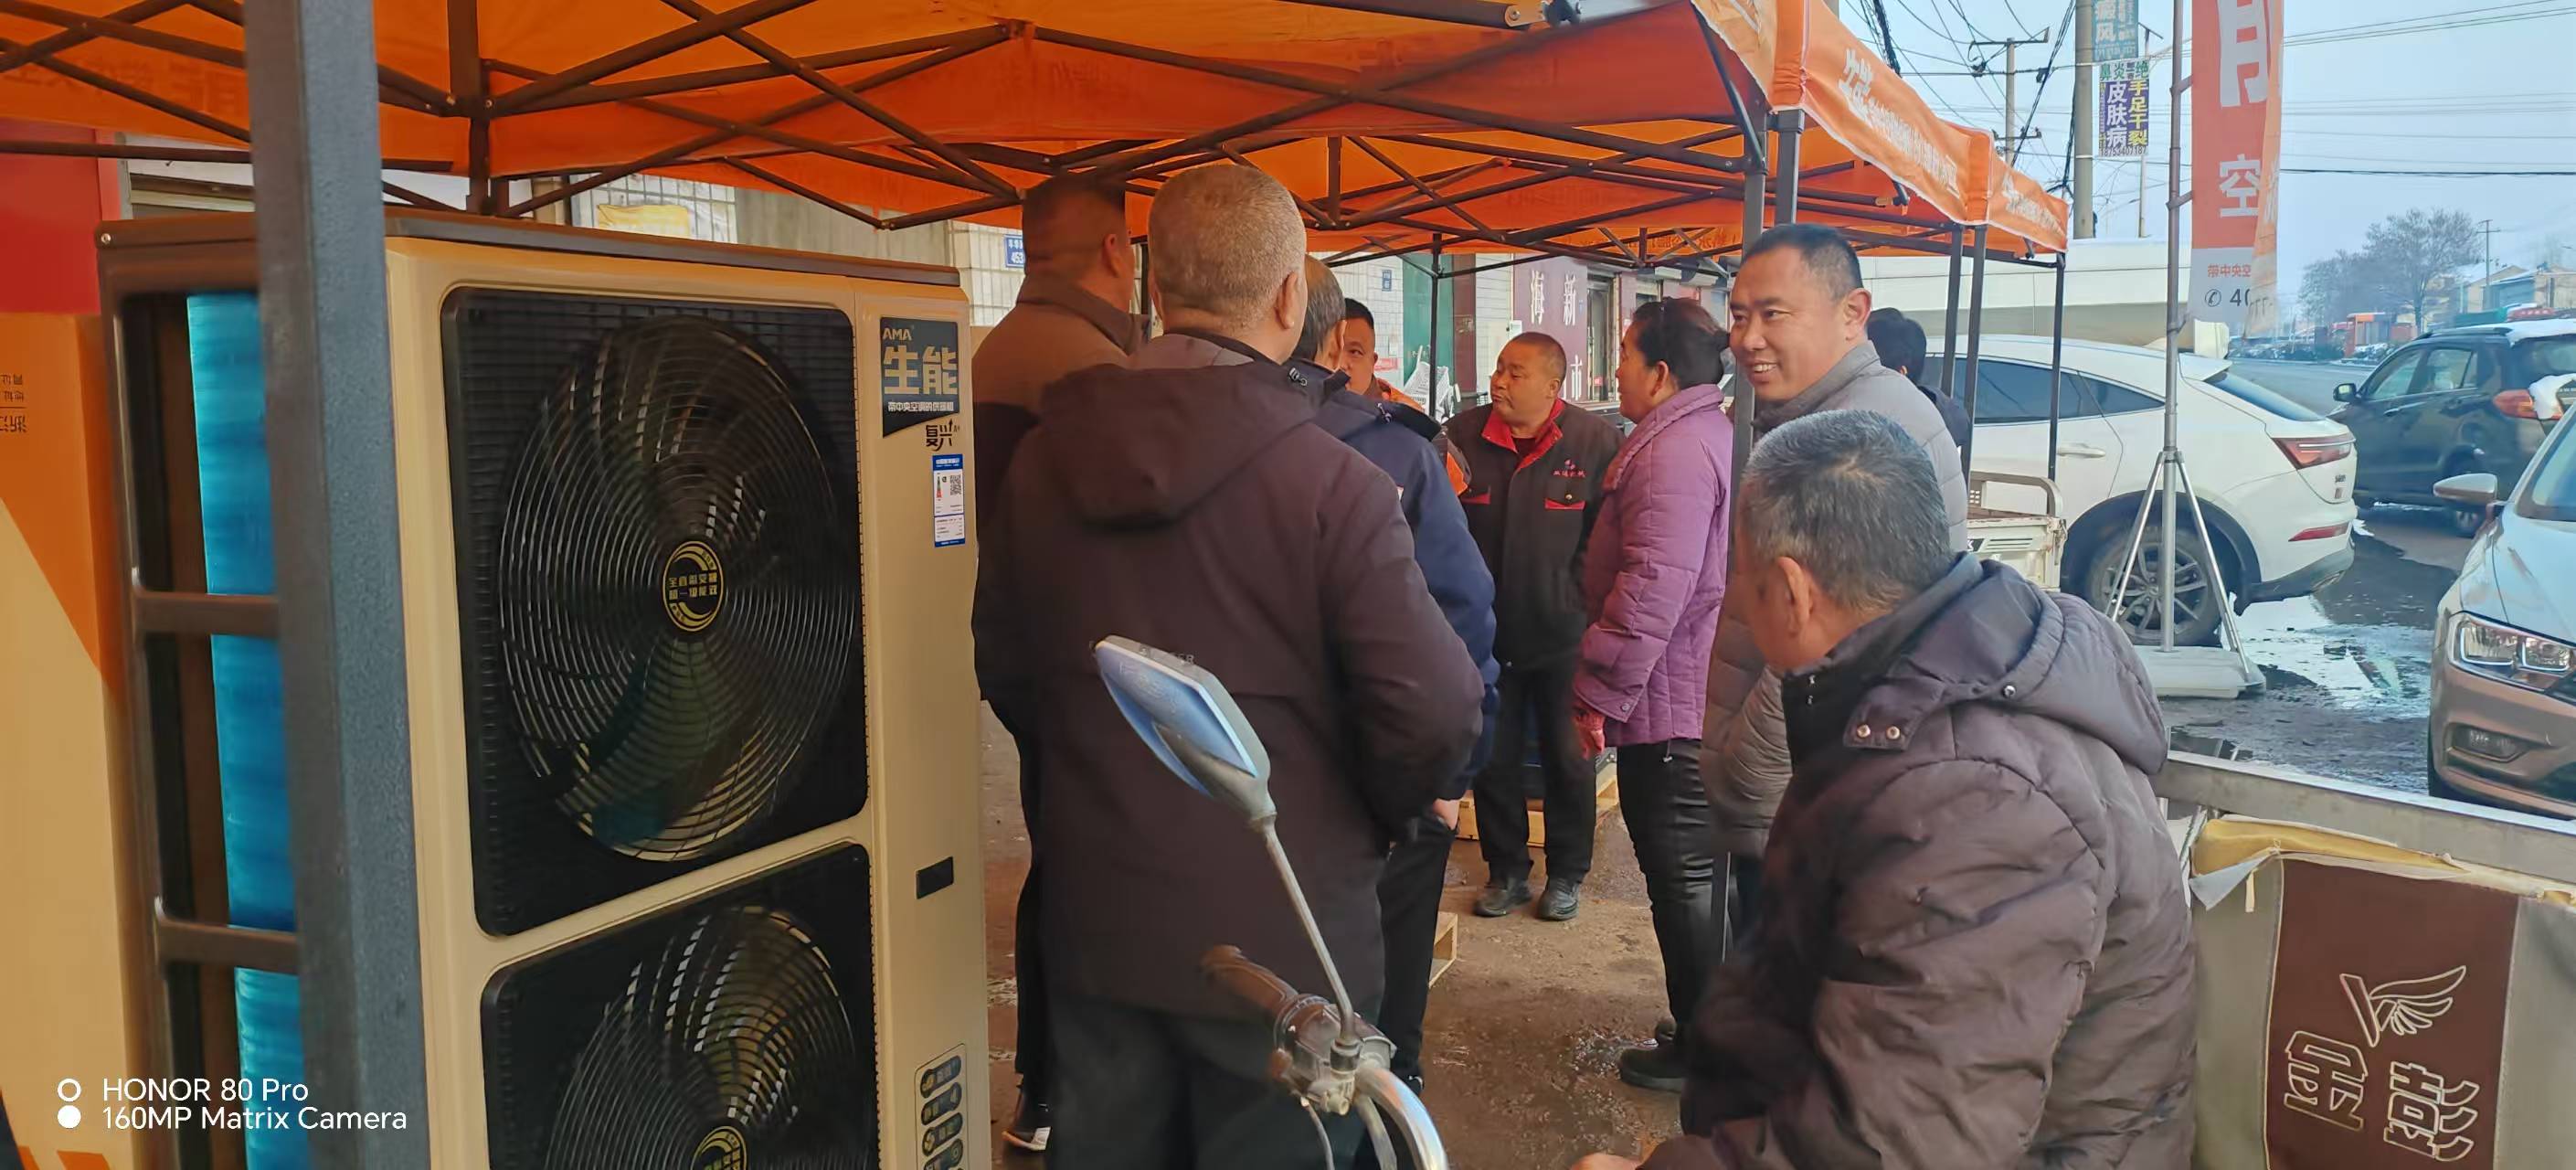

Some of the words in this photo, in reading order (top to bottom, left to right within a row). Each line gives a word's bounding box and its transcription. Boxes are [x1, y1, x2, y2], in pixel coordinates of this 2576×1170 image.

[2107, 81, 2127, 147] 皮肤病
[2128, 80, 2148, 146] 手足干裂
[883, 327, 912, 341] AMA
[883, 345, 958, 395] 生能
[926, 419, 953, 452] 复兴
